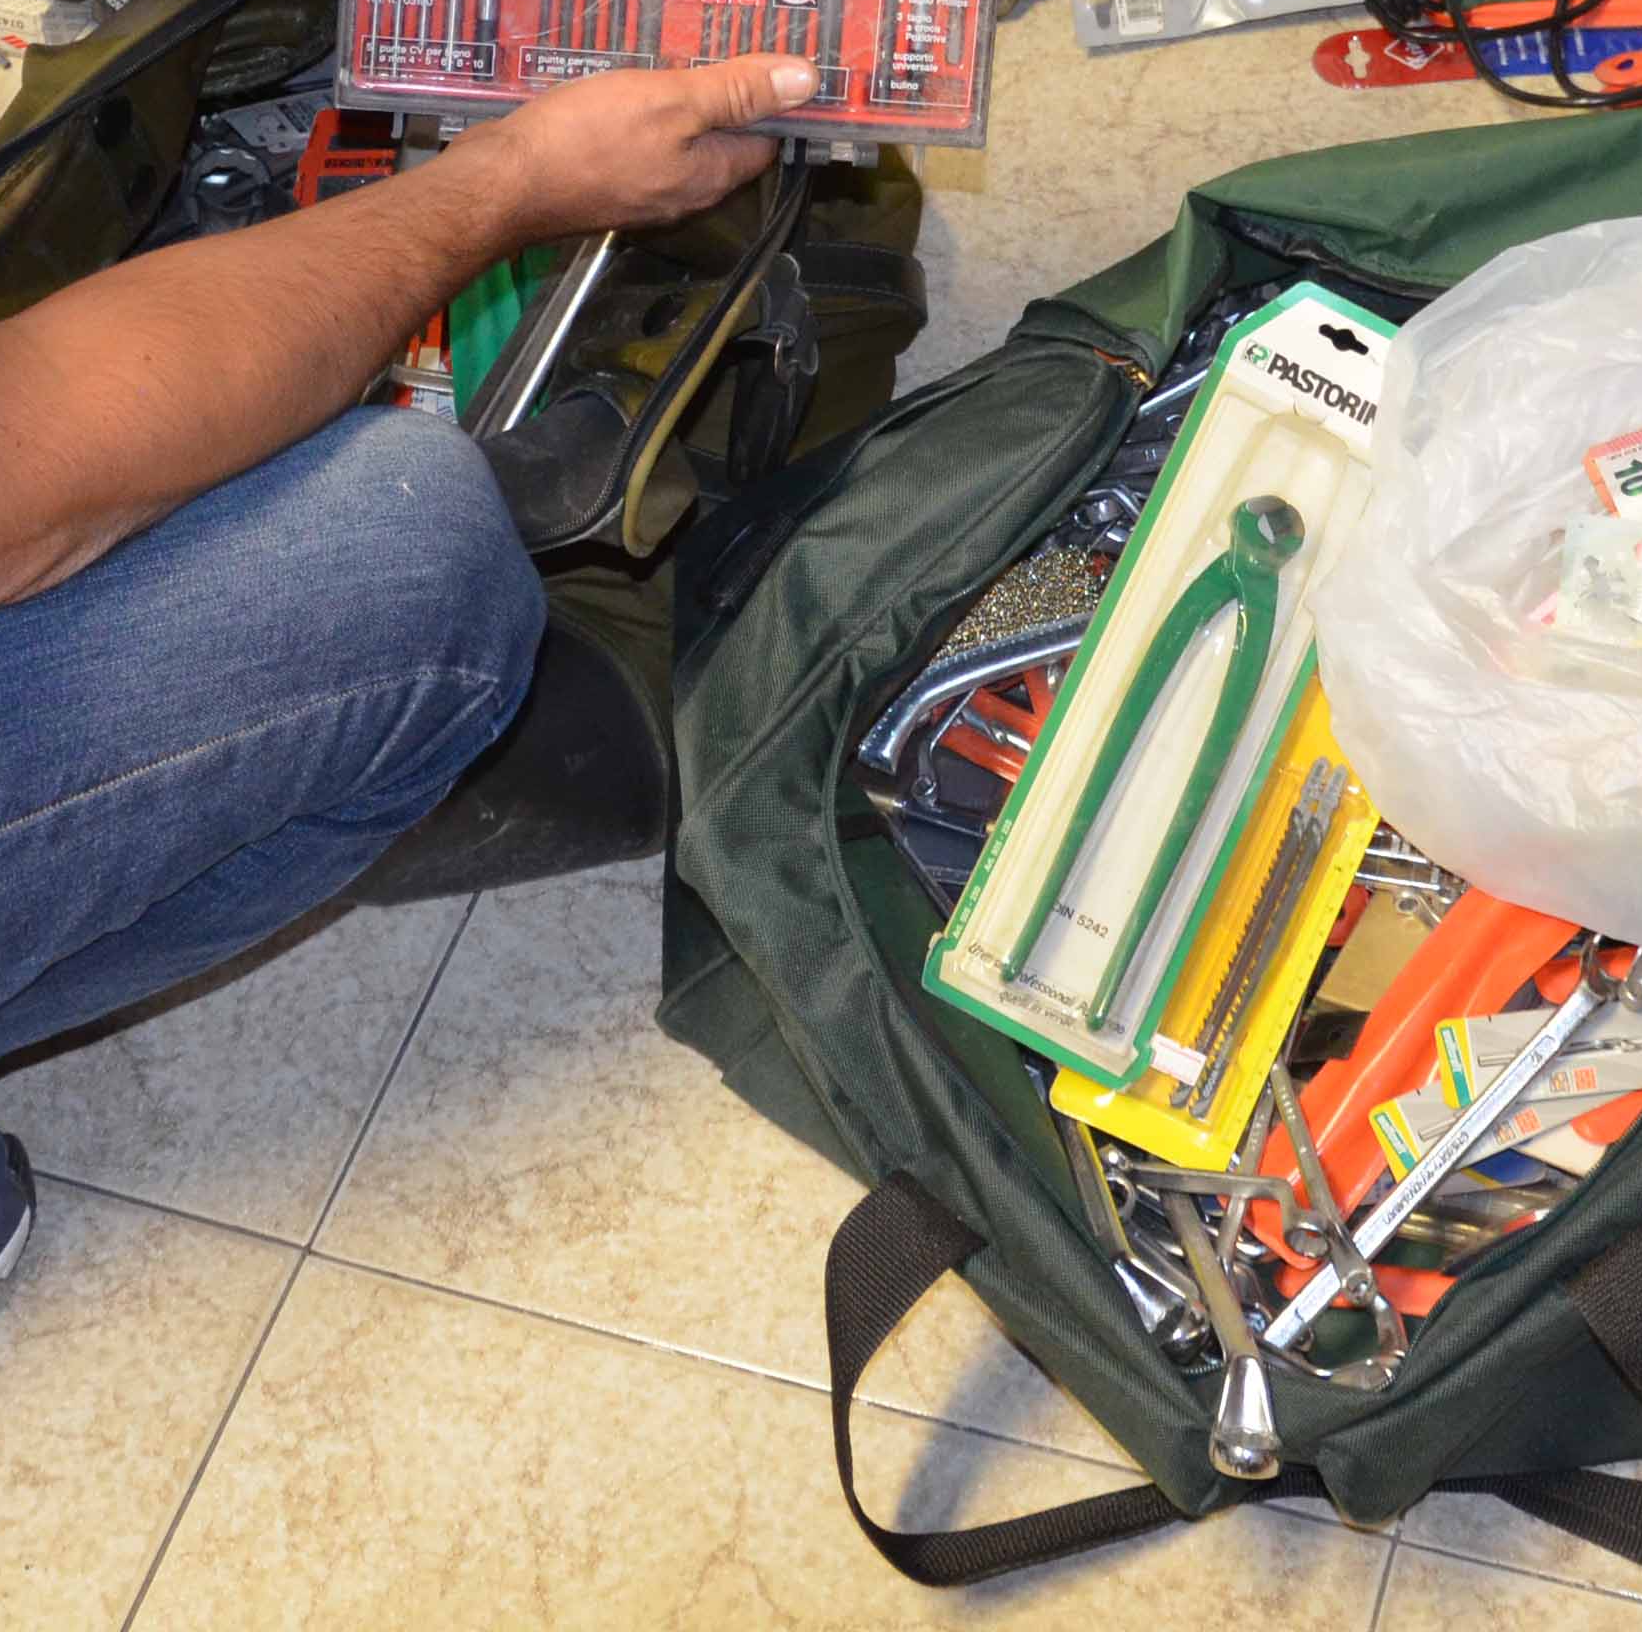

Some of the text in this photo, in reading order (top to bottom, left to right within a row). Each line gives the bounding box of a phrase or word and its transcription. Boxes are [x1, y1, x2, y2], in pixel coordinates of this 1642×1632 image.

[409, 45, 425, 56] CV
[426, 48, 443, 60] per
[893, 52, 934, 63] supporto
[473, 59, 484, 69] 10
[538, 55, 566, 67] punte
[568, 57, 584, 68] per
[585, 58, 612, 68] muro
[892, 62, 939, 73] universale
[890, 79, 920, 91] bulino
[1266, 352, 1379, 428] PASTORIN
[1076, 914, 1109, 940] 5242
